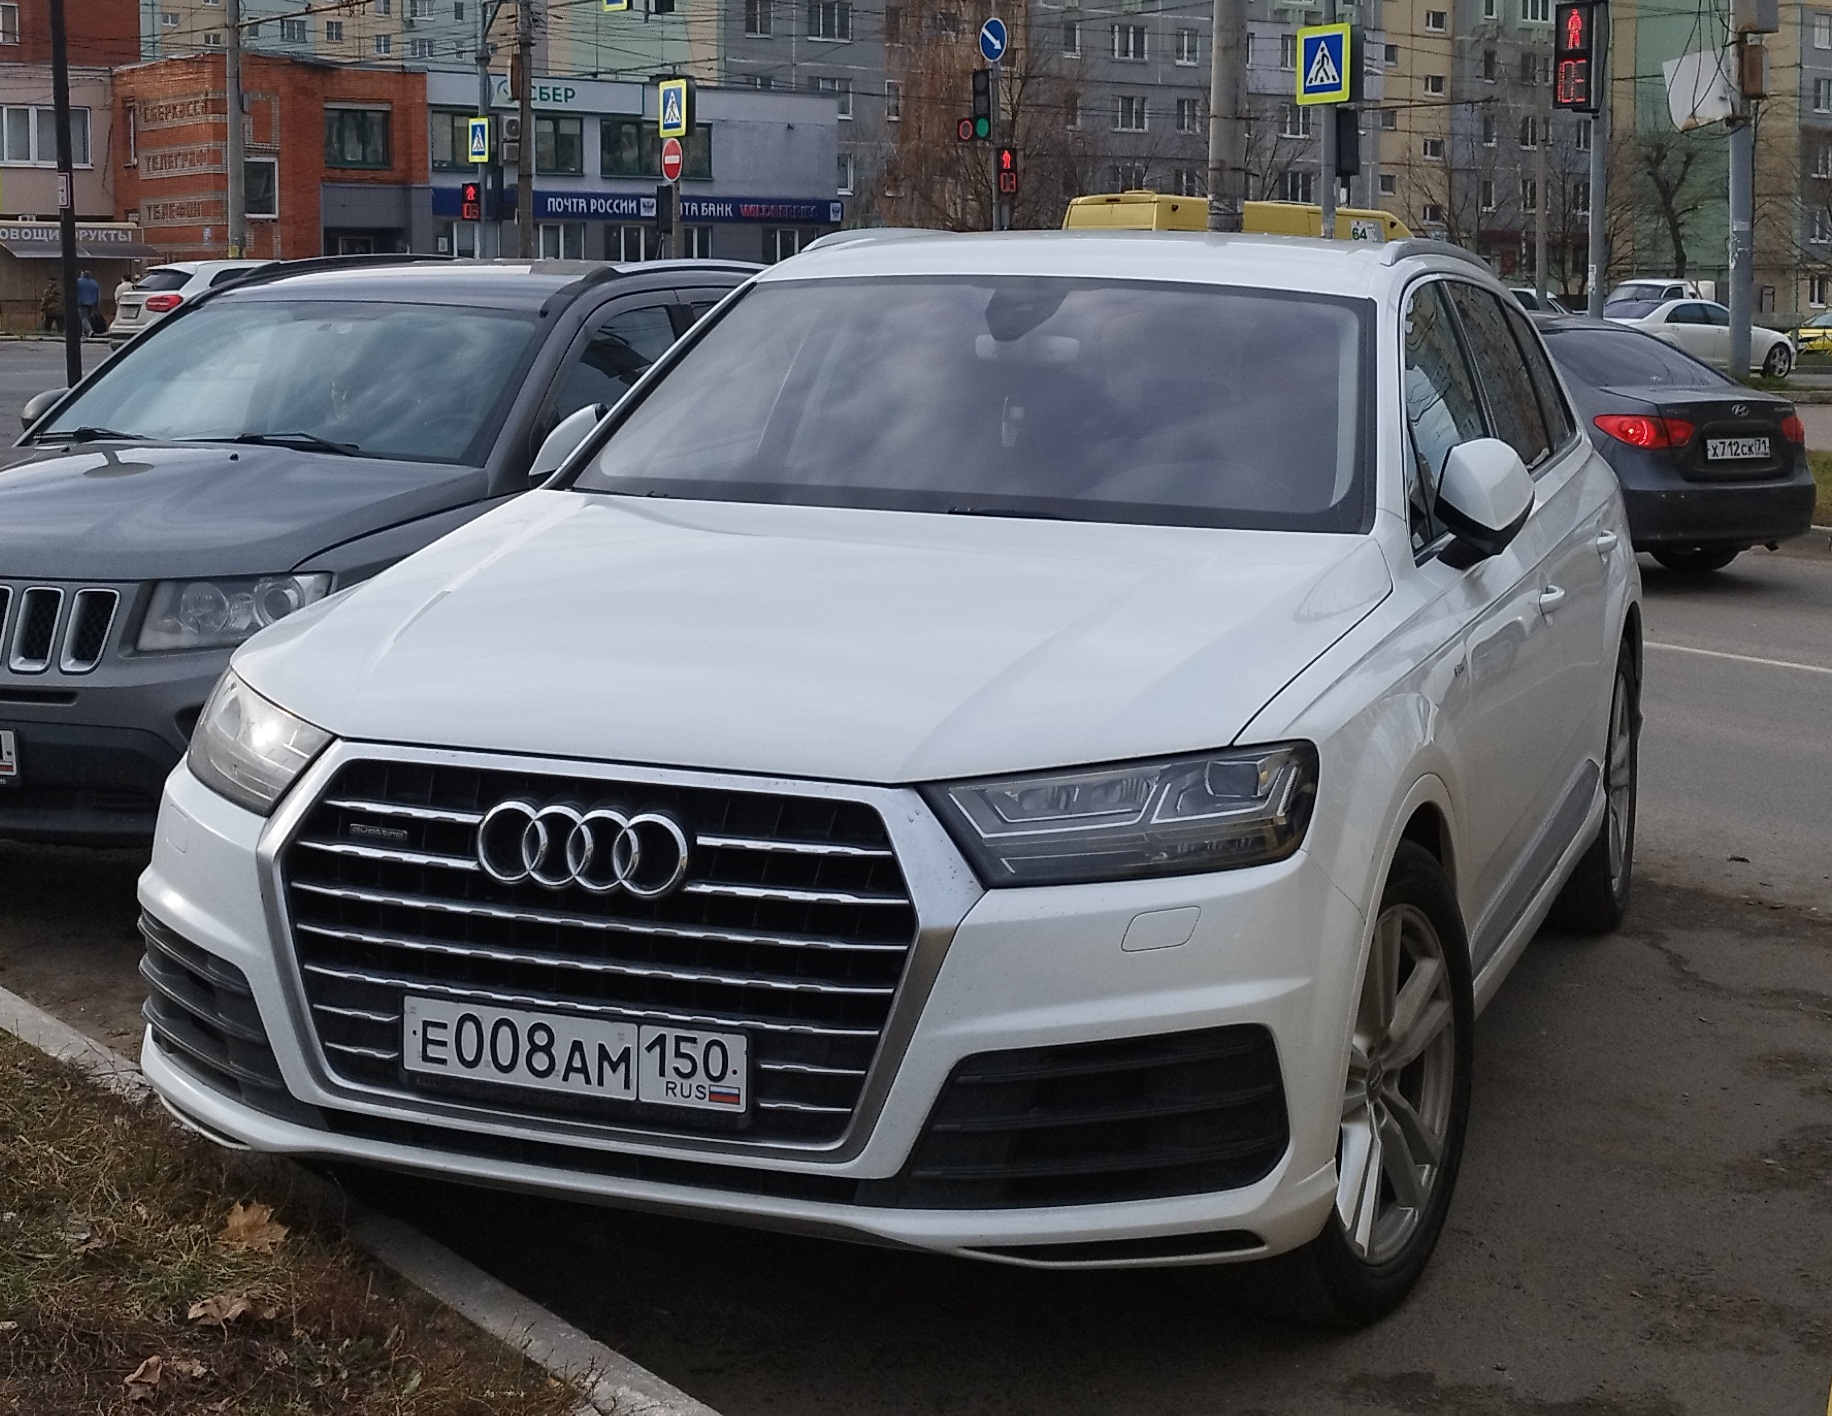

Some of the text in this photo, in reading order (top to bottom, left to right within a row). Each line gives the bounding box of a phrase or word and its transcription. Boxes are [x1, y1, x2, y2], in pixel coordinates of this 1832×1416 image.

[547, 198, 636, 214] ПОЧТА РОССИИ
[701, 202, 733, 217] БАНК
[0, 228, 132, 242] ОВОЩИ РУКТЫ
[1352, 227, 1367, 240] 64
[1756, 439, 1766, 451] 71
[420, 1011, 632, 1090] Е008АМ
[644, 1033, 729, 1082] 150
[665, 1081, 707, 1100] RUS
